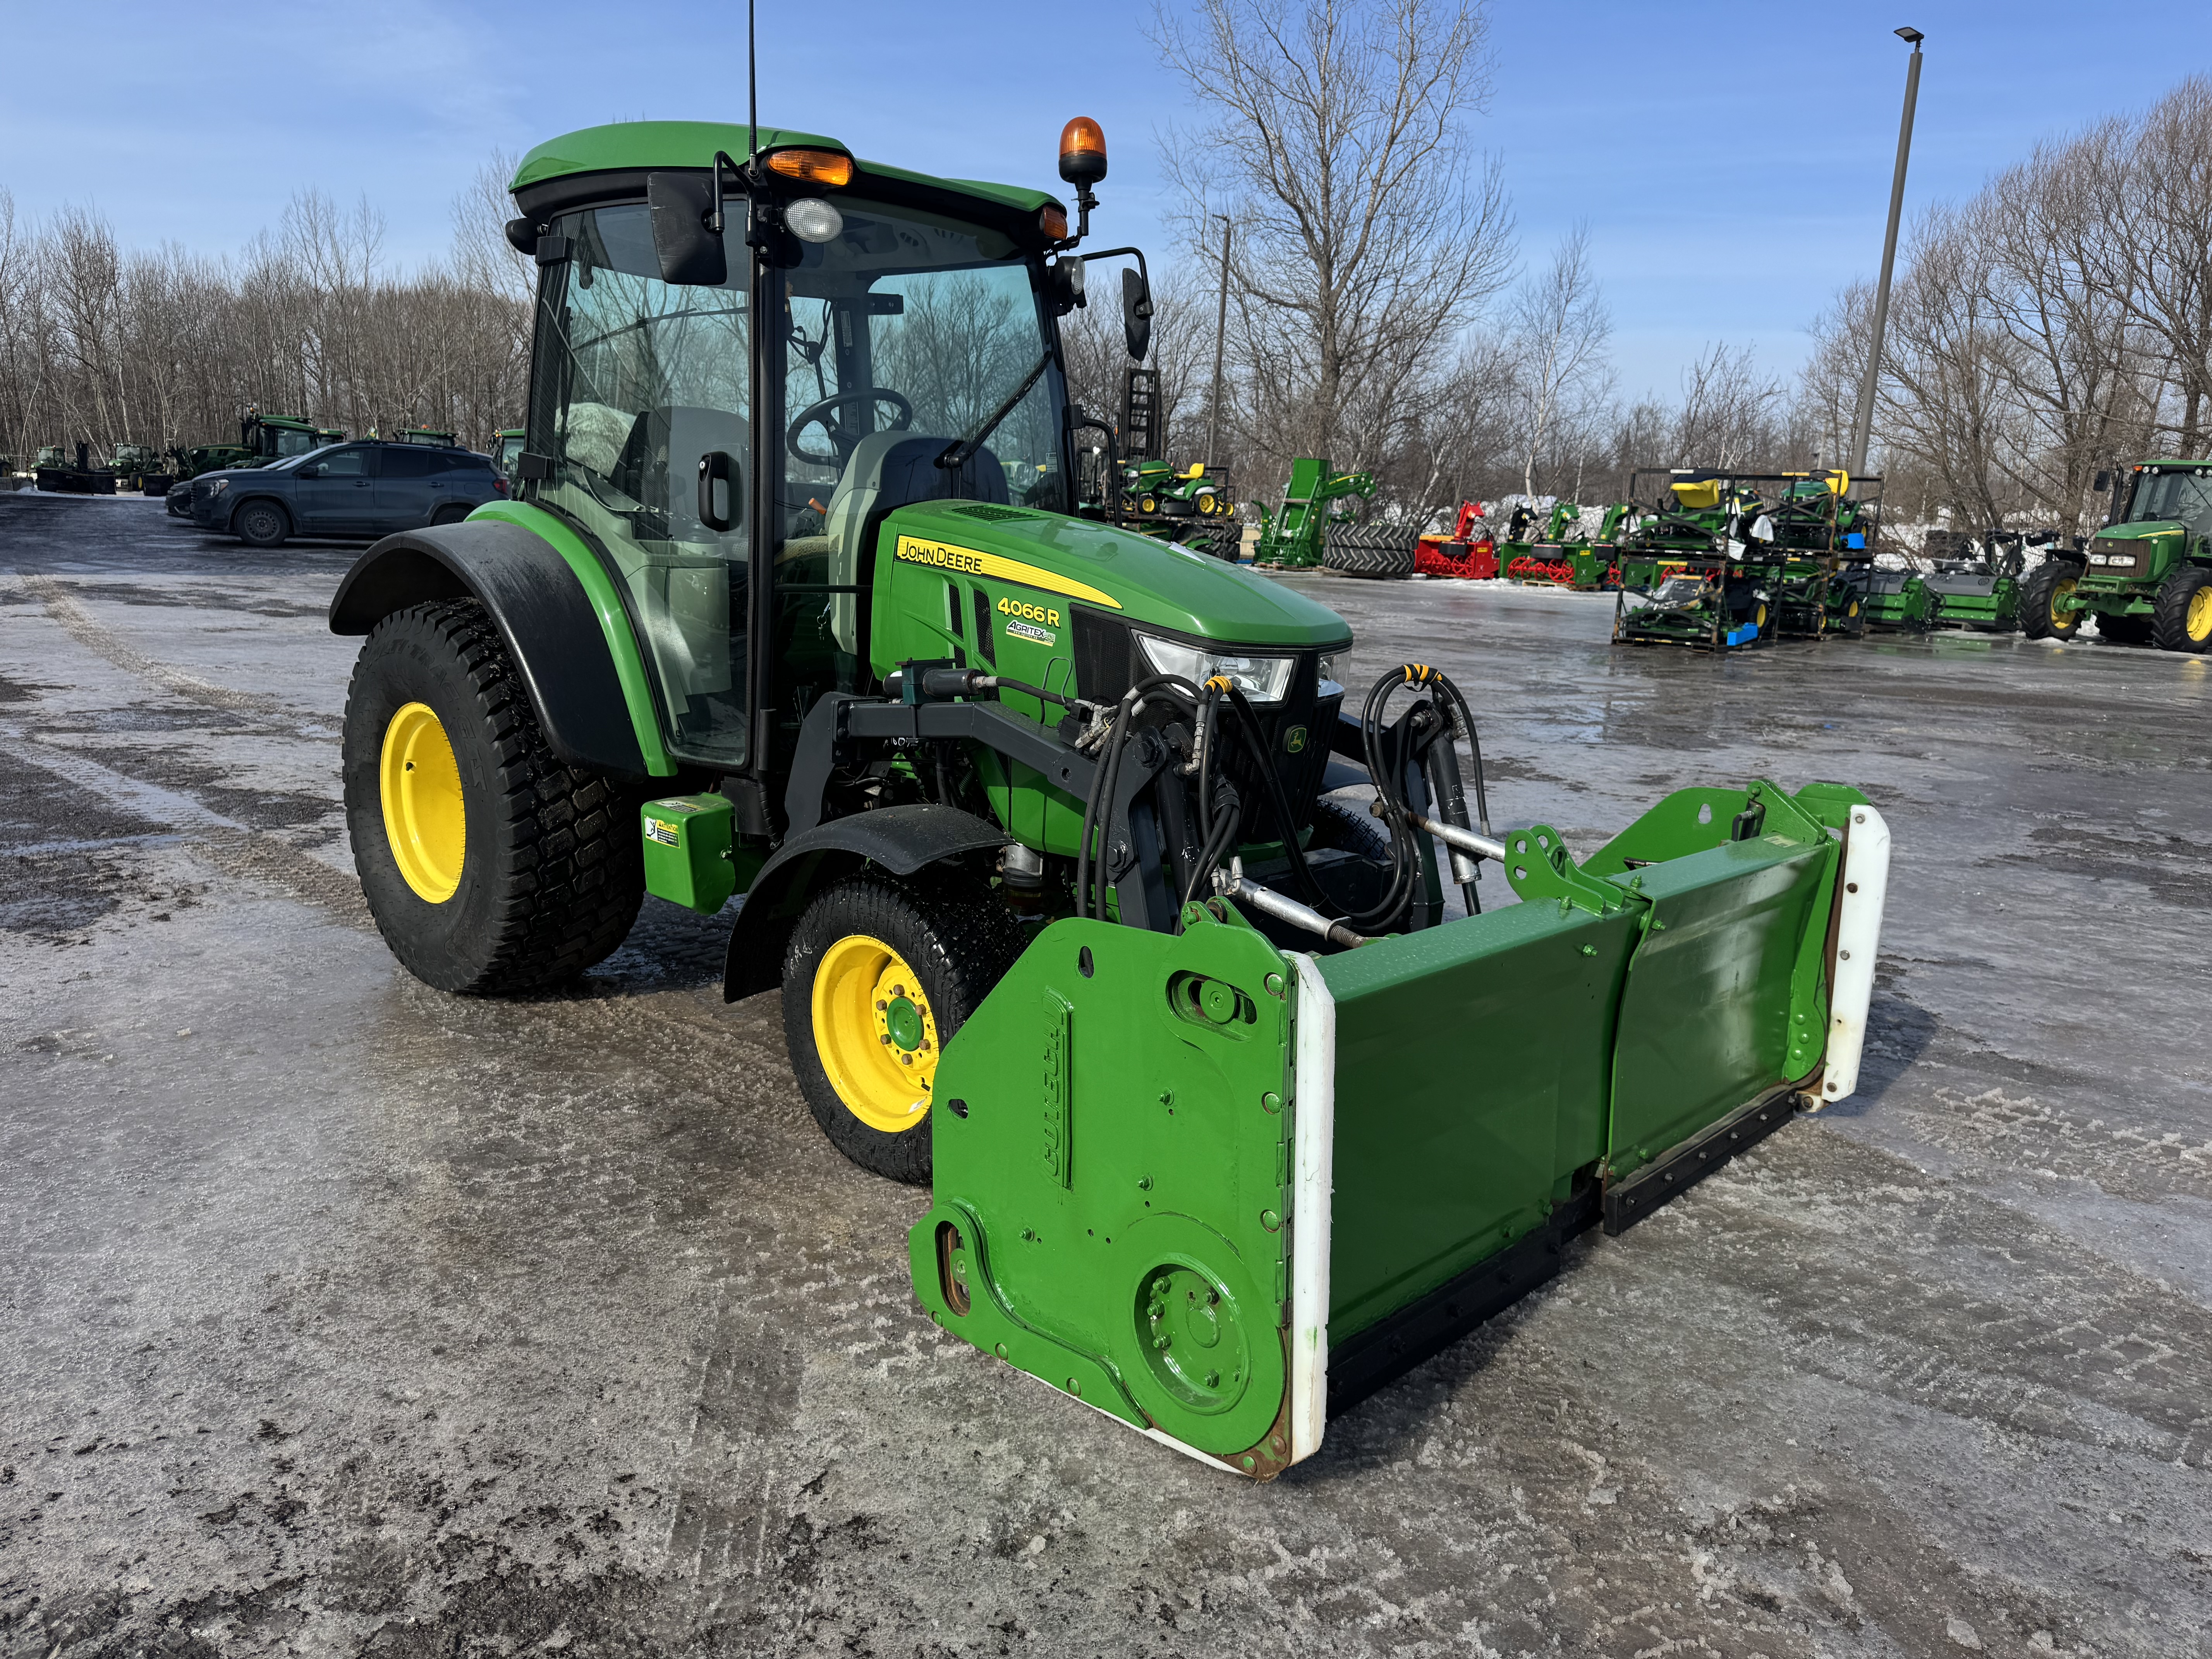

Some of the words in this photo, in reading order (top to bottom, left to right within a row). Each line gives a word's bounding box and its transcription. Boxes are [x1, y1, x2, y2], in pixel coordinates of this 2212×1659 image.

[902, 541, 934, 562] JOHN
[936, 547, 982, 572] DEERE
[1008, 621, 1044, 637] AGRITEX
[410, 644, 461, 702] TRAC
